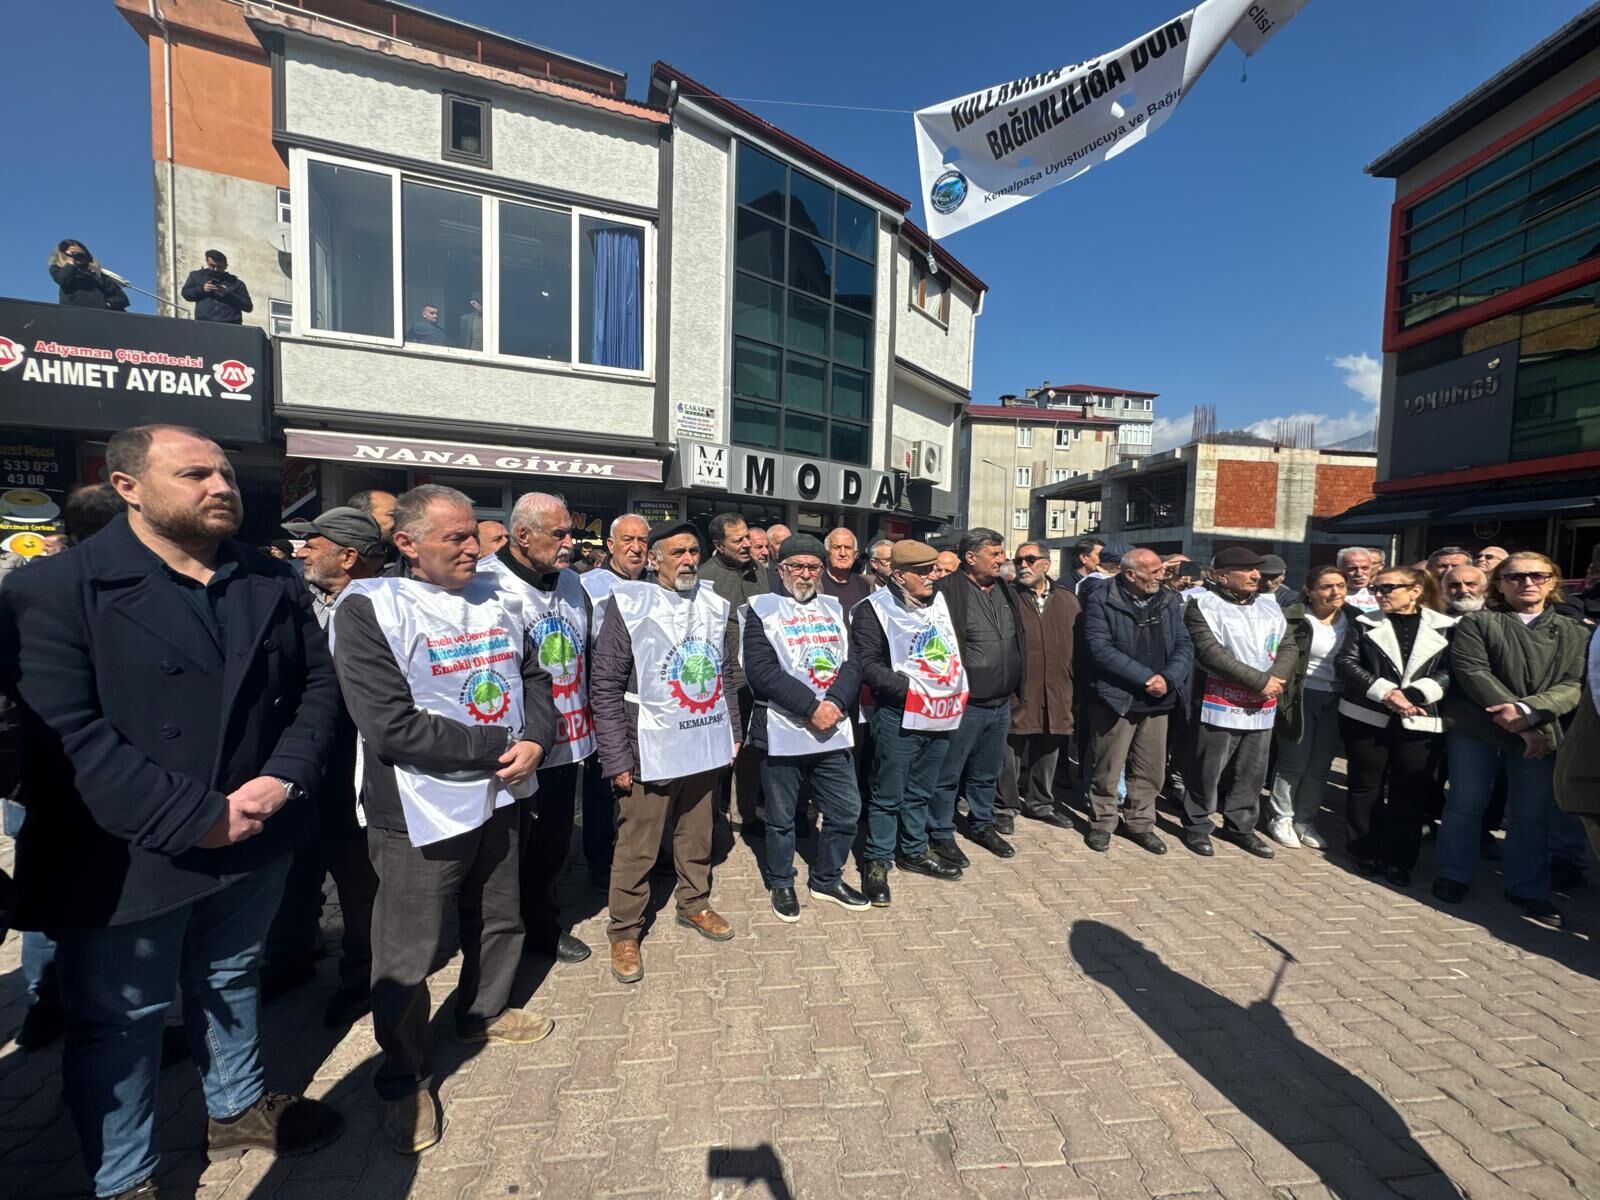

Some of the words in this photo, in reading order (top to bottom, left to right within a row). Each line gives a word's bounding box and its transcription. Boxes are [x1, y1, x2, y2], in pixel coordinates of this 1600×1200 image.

[984, 170, 1043, 203] Kemalpaşa
[1045, 125, 1128, 175] Uyuşturucuya
[1128, 112, 1145, 128] ve
[34, 340, 113, 360] Adıyaman
[115, 348, 204, 369] Çiğköftecisi
[22, 357, 119, 389] AHMET
[126, 367, 212, 397] AYBAK
[3, 459, 30, 472] 533
[353, 444, 482, 467] NANA
[495, 455, 615, 476] GİYİM
[744, 454, 896, 509] MODA
[431, 659, 472, 676] Emekli
